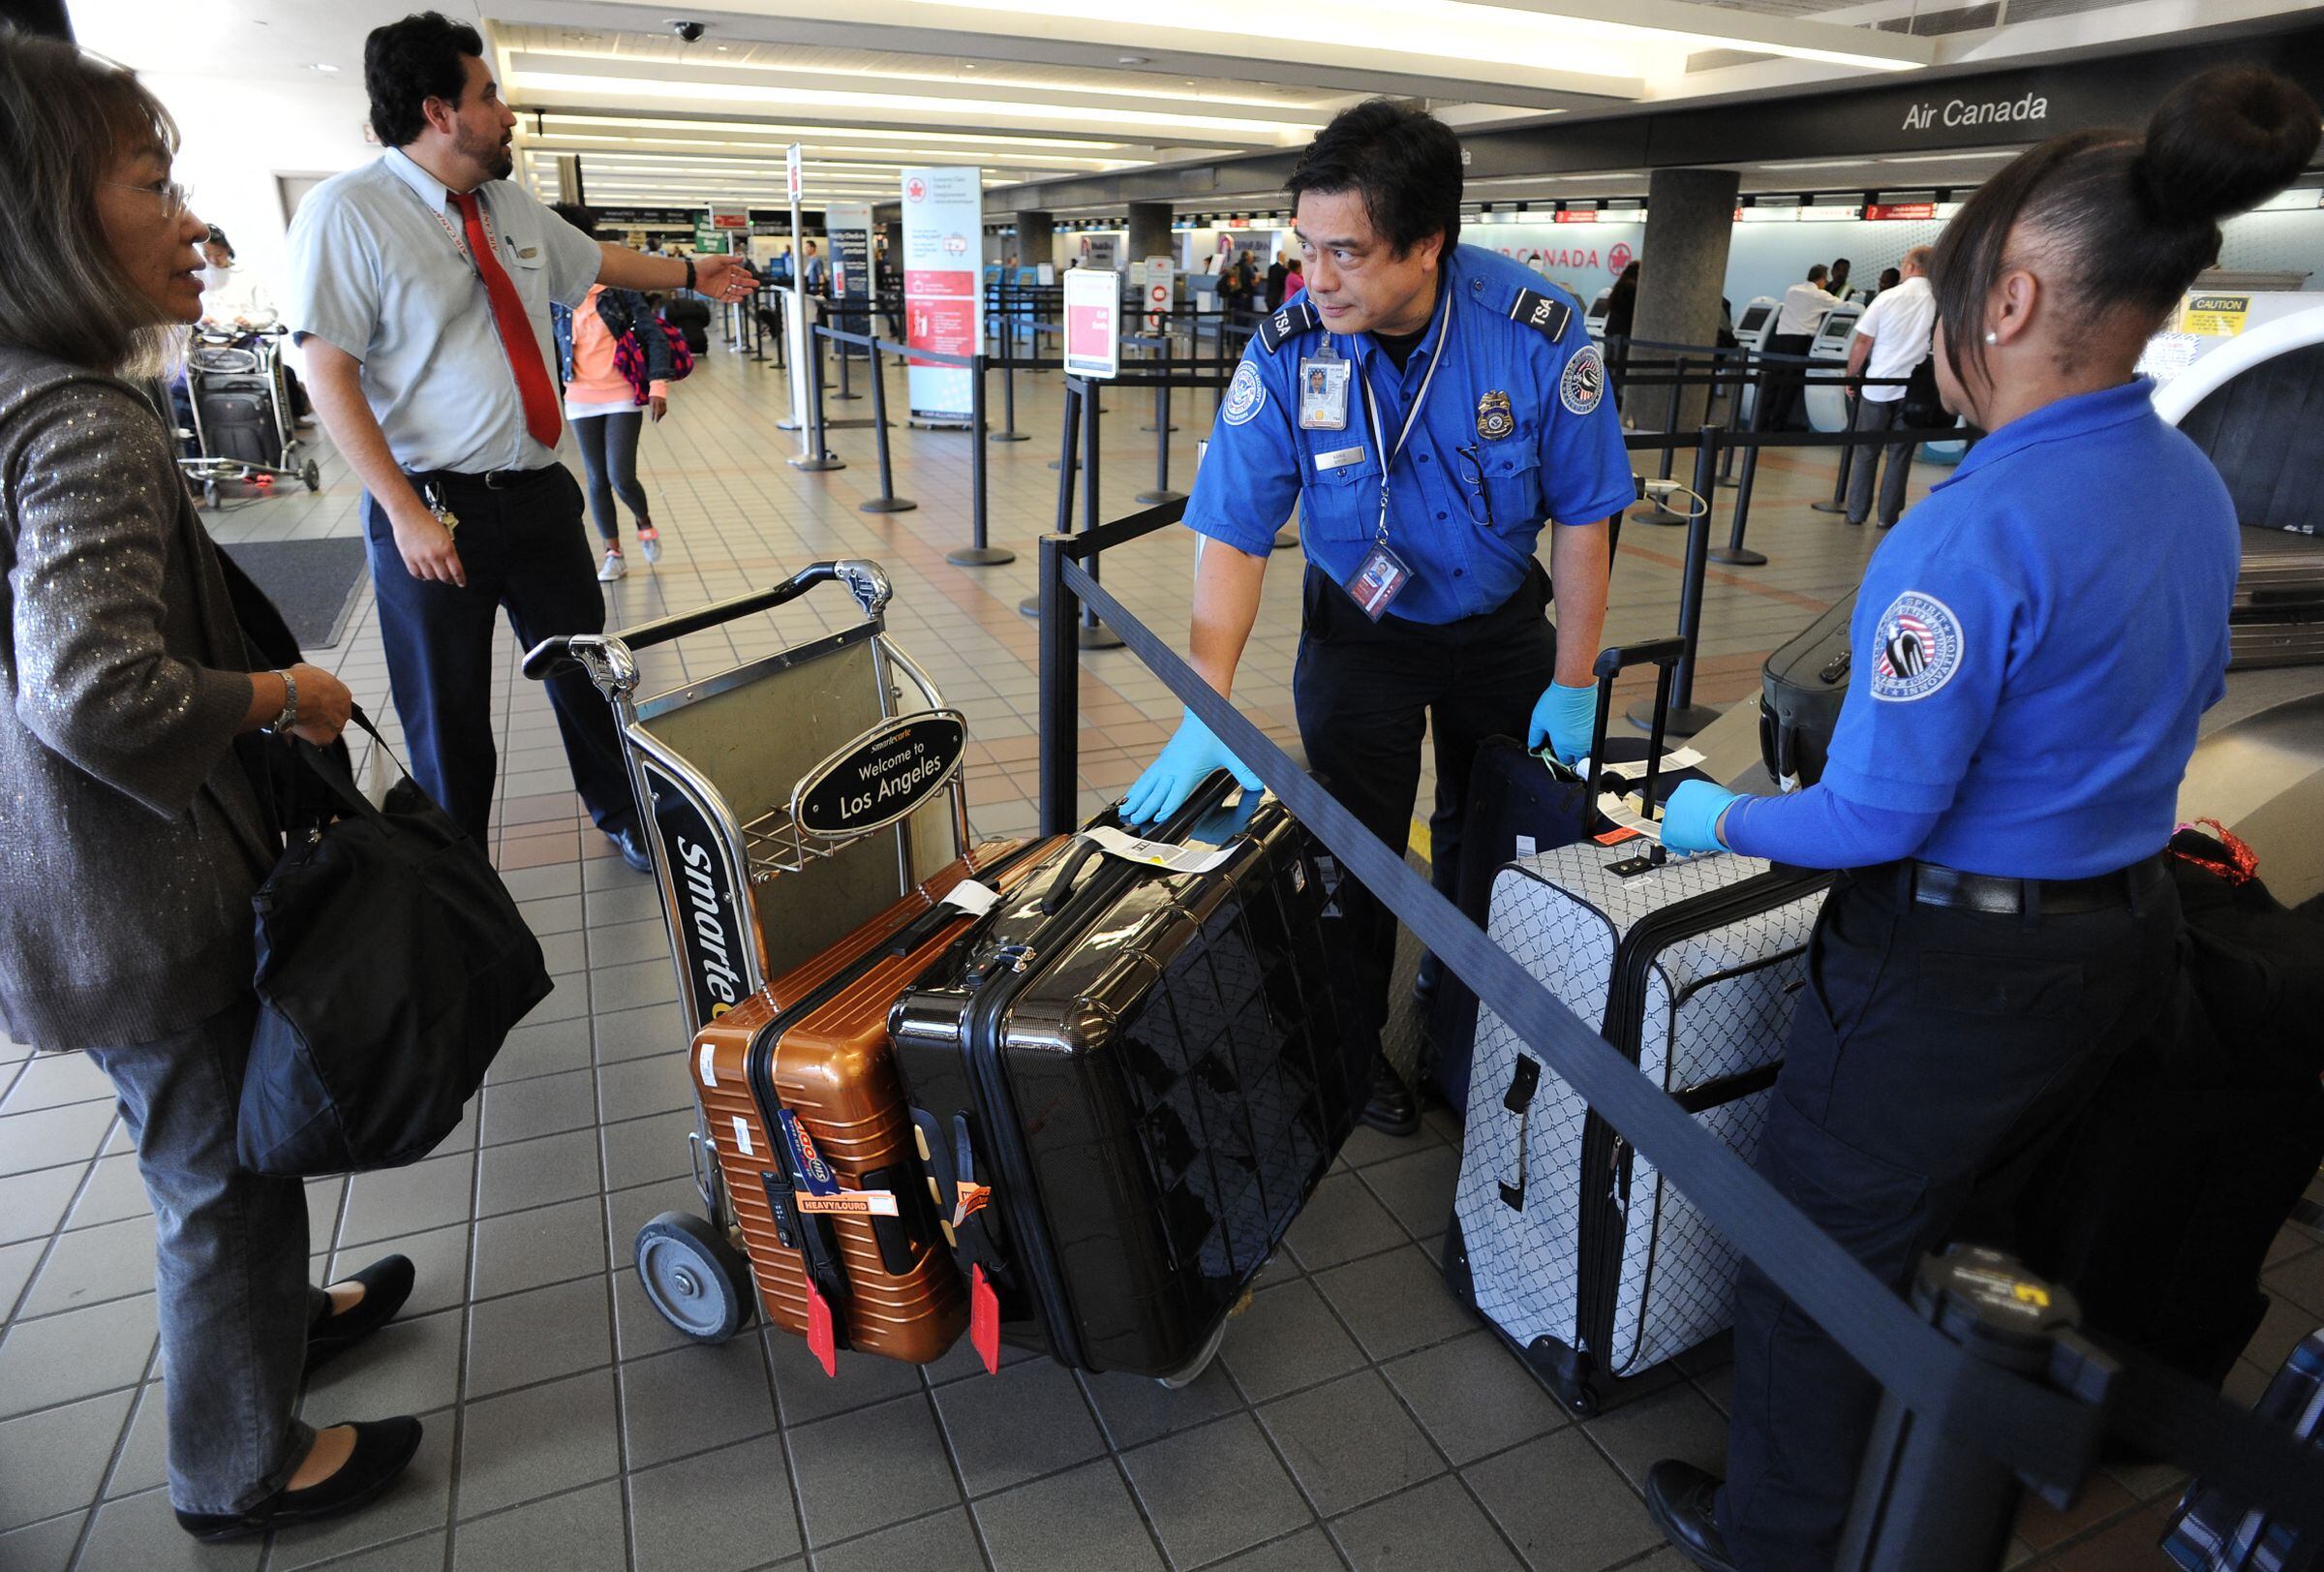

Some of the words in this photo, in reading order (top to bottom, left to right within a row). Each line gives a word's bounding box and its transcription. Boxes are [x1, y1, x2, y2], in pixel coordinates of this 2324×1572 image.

[1902, 103, 1938, 131] Air
[1943, 92, 2048, 127] Canada
[1530, 298, 1554, 325] TSA
[2196, 299, 2244, 310] CAUTION
[1273, 309, 1292, 338] TSA
[1906, 597, 1947, 624] SPIRIT
[1903, 633, 1956, 696] INNOVATION
[858, 758, 911, 782] Welcome
[914, 742, 925, 755] to
[840, 791, 872, 819] Los
[877, 755, 941, 803] Angeles
[804, 1201, 868, 1211] HEAVY/LOURD
